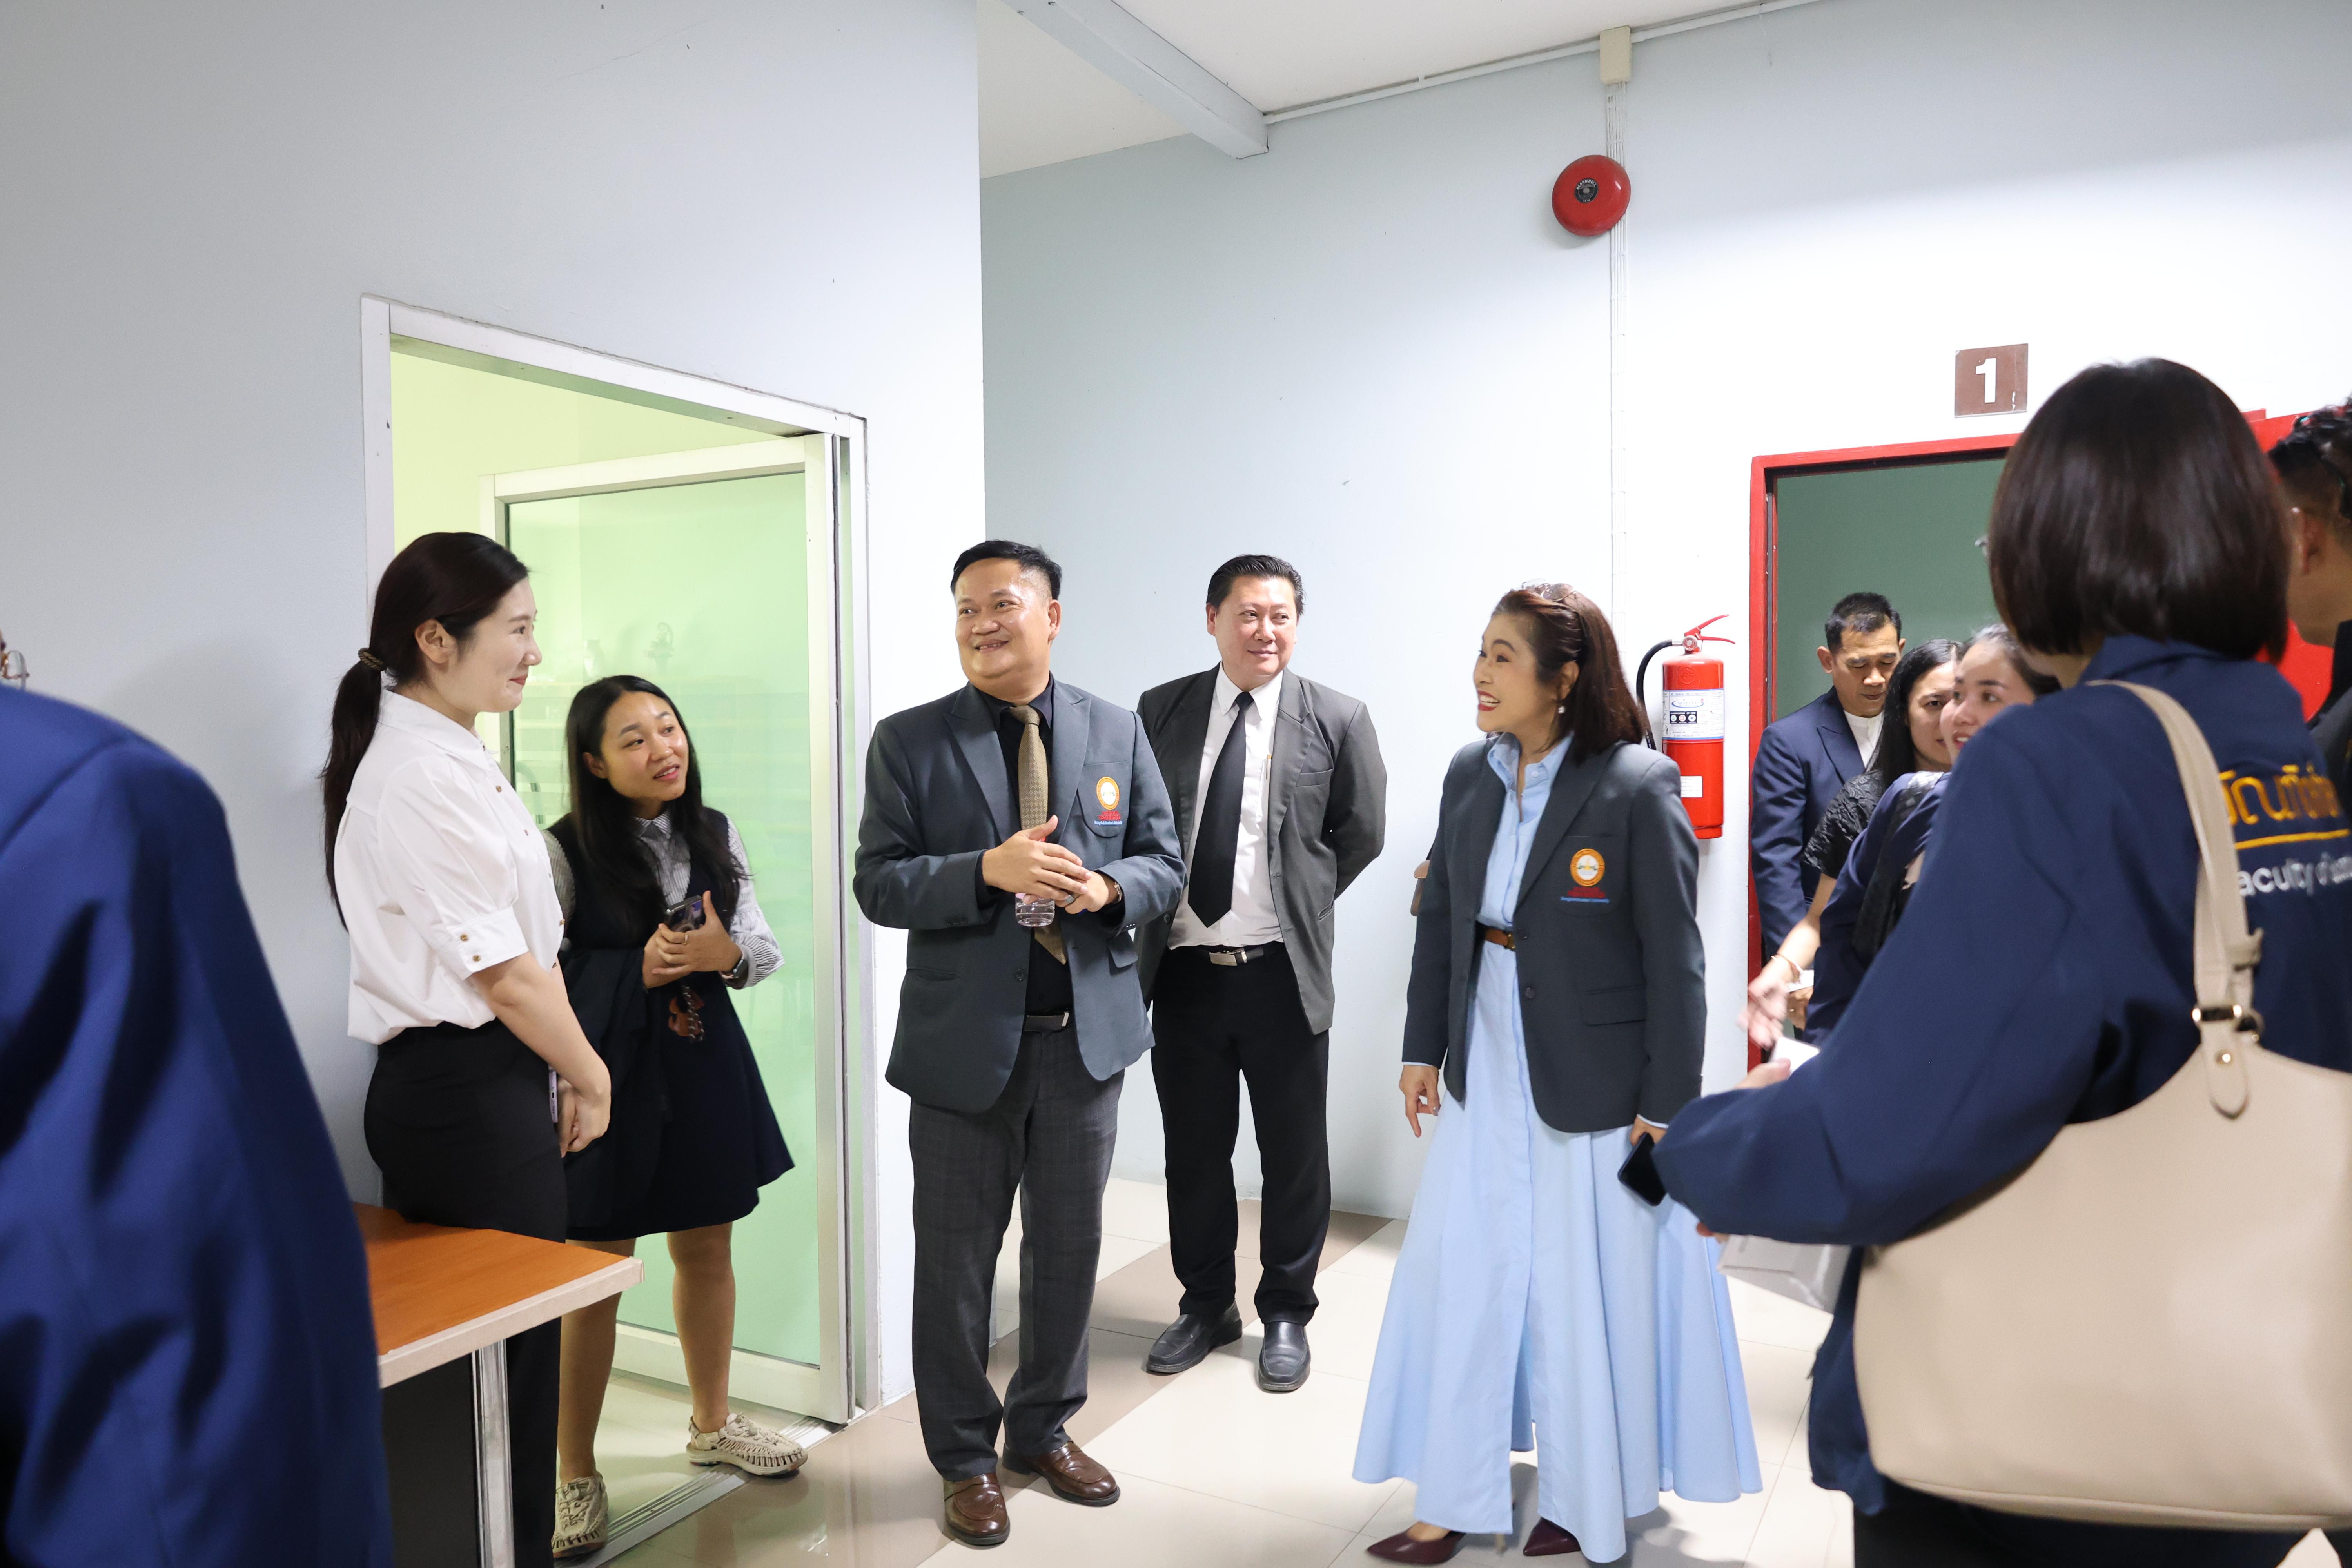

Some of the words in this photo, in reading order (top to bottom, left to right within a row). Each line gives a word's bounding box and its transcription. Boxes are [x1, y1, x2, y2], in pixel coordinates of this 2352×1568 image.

[1577, 180, 1588, 190] ALARM
[1975, 358, 1996, 403] 1
[2236, 857, 2314, 897] aculty
